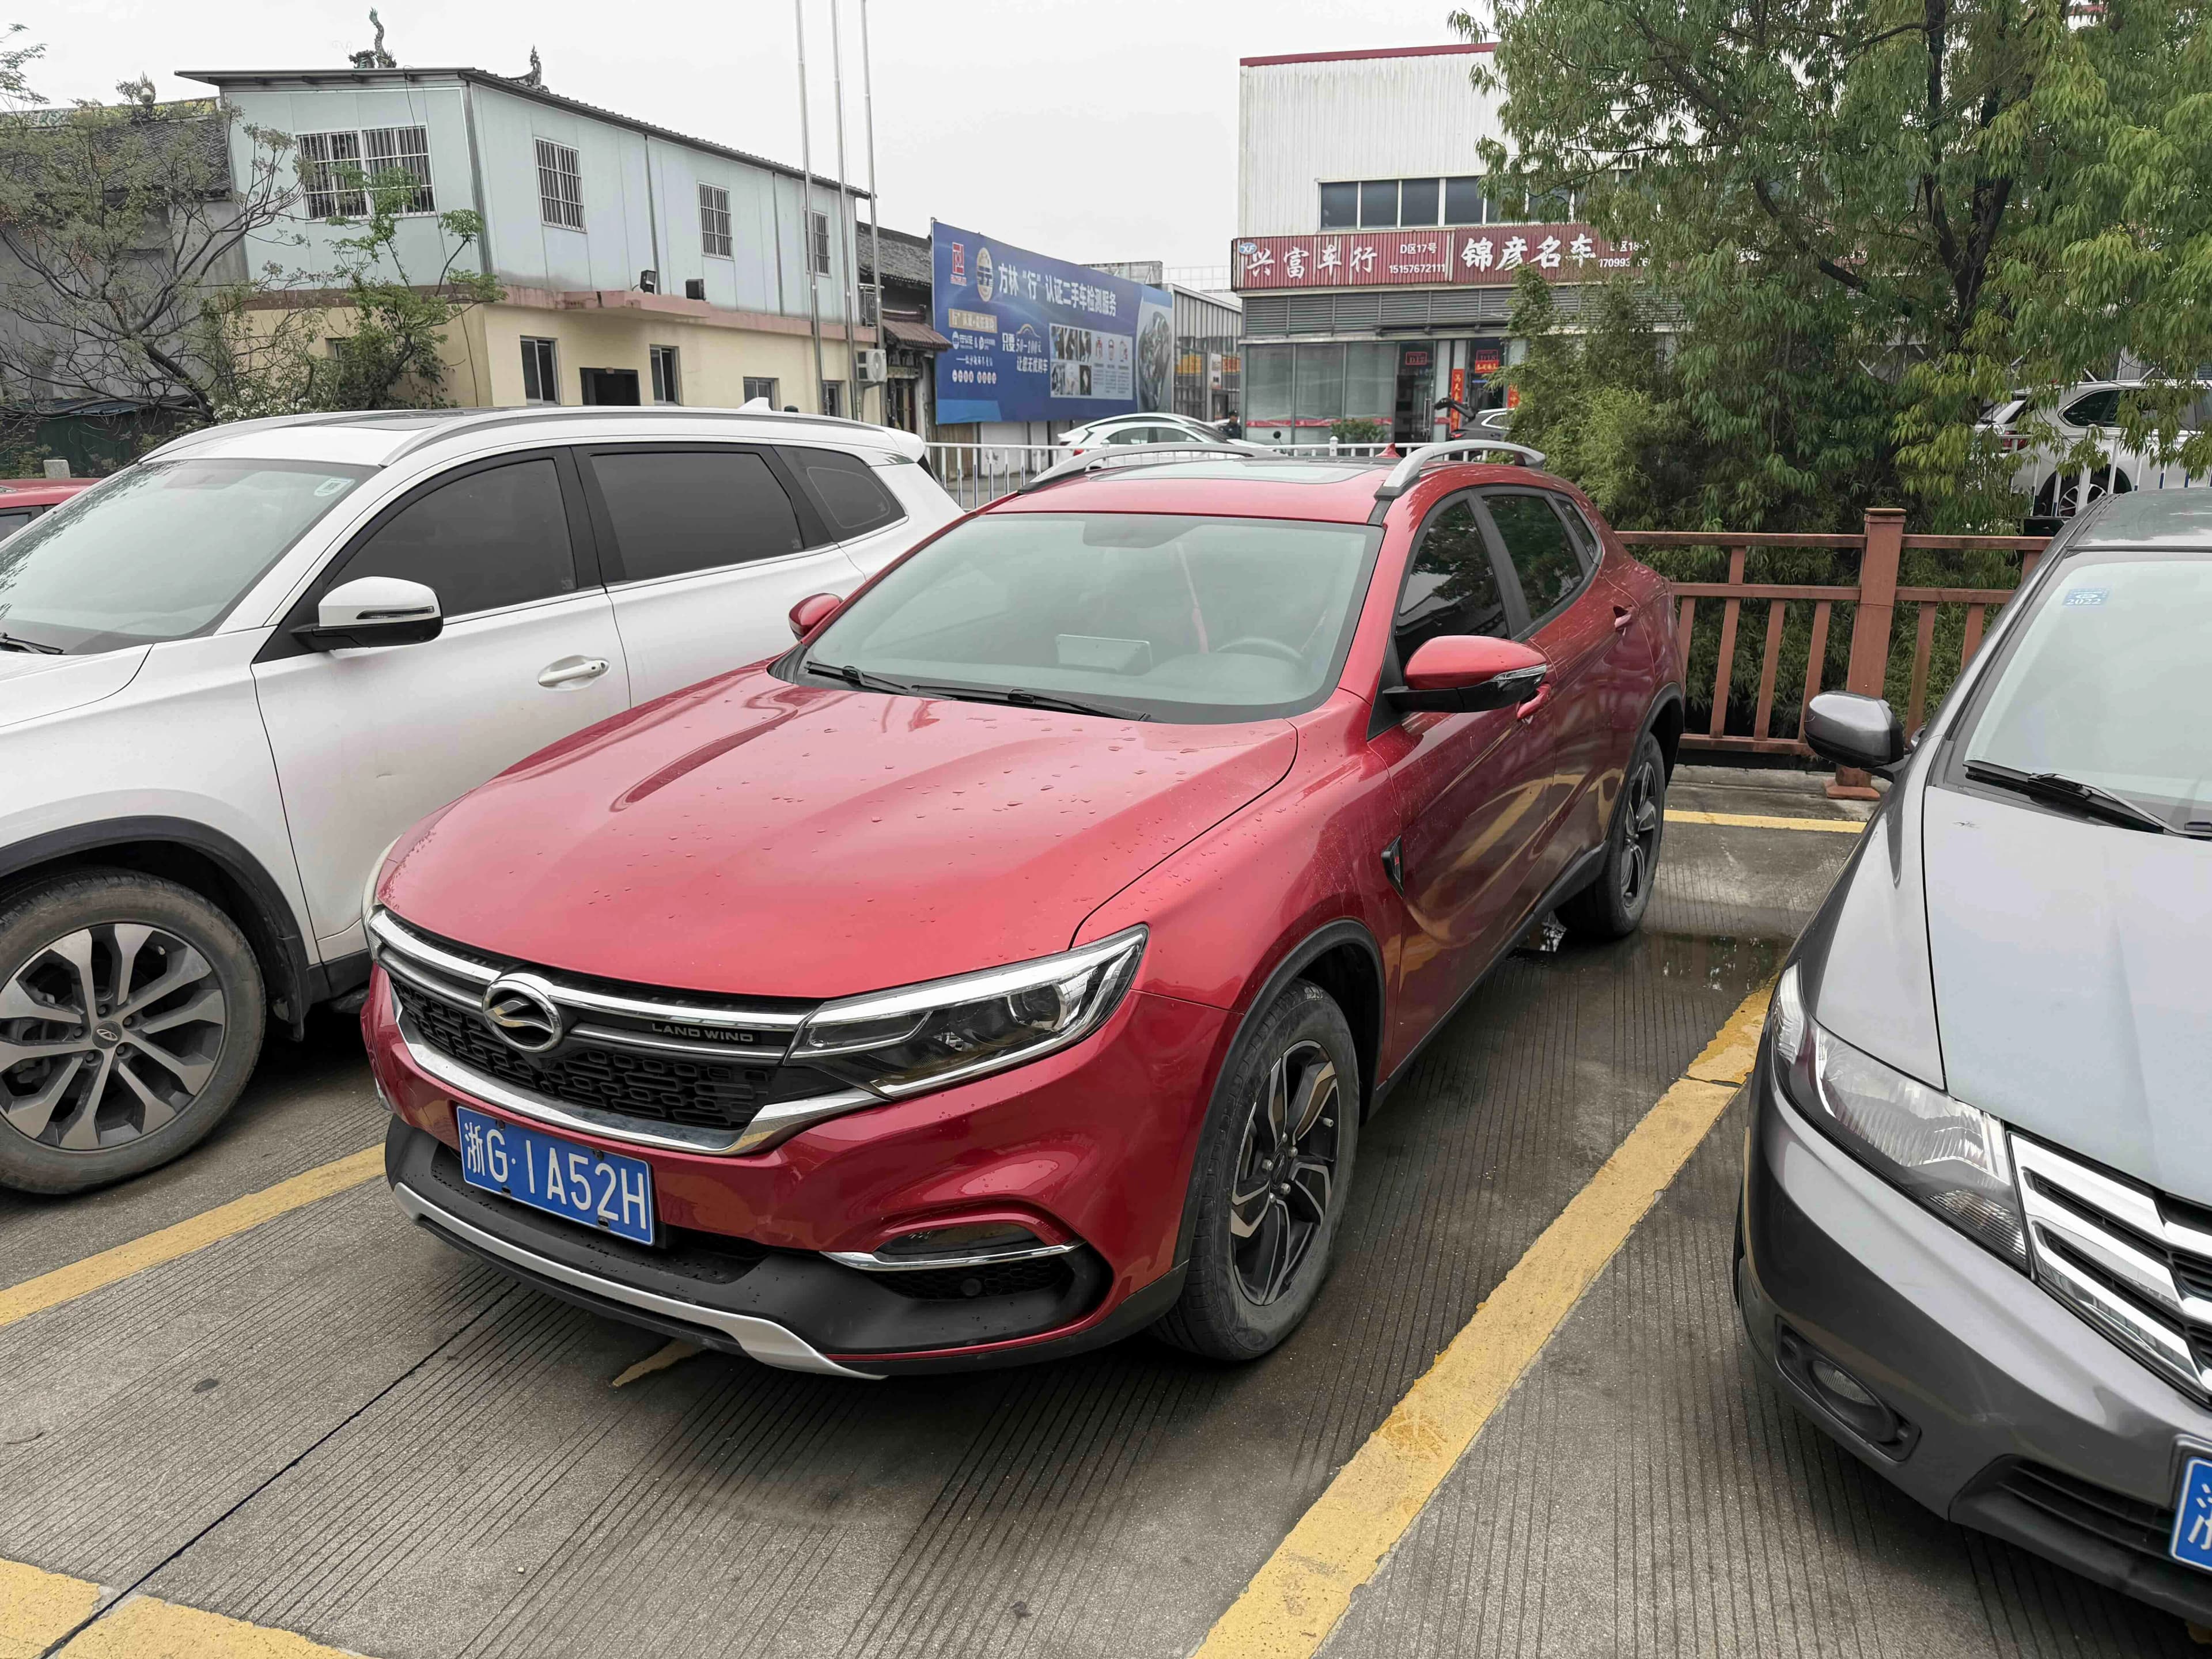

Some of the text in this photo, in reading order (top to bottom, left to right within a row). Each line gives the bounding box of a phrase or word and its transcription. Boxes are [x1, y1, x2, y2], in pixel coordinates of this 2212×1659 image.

[1400, 243, 1437, 254] D区17号
[1461, 232, 1596, 272] 锦彦名车
[1389, 263, 1445, 274] 15157672111
[652, 1022, 753, 1042] LAND WIND
